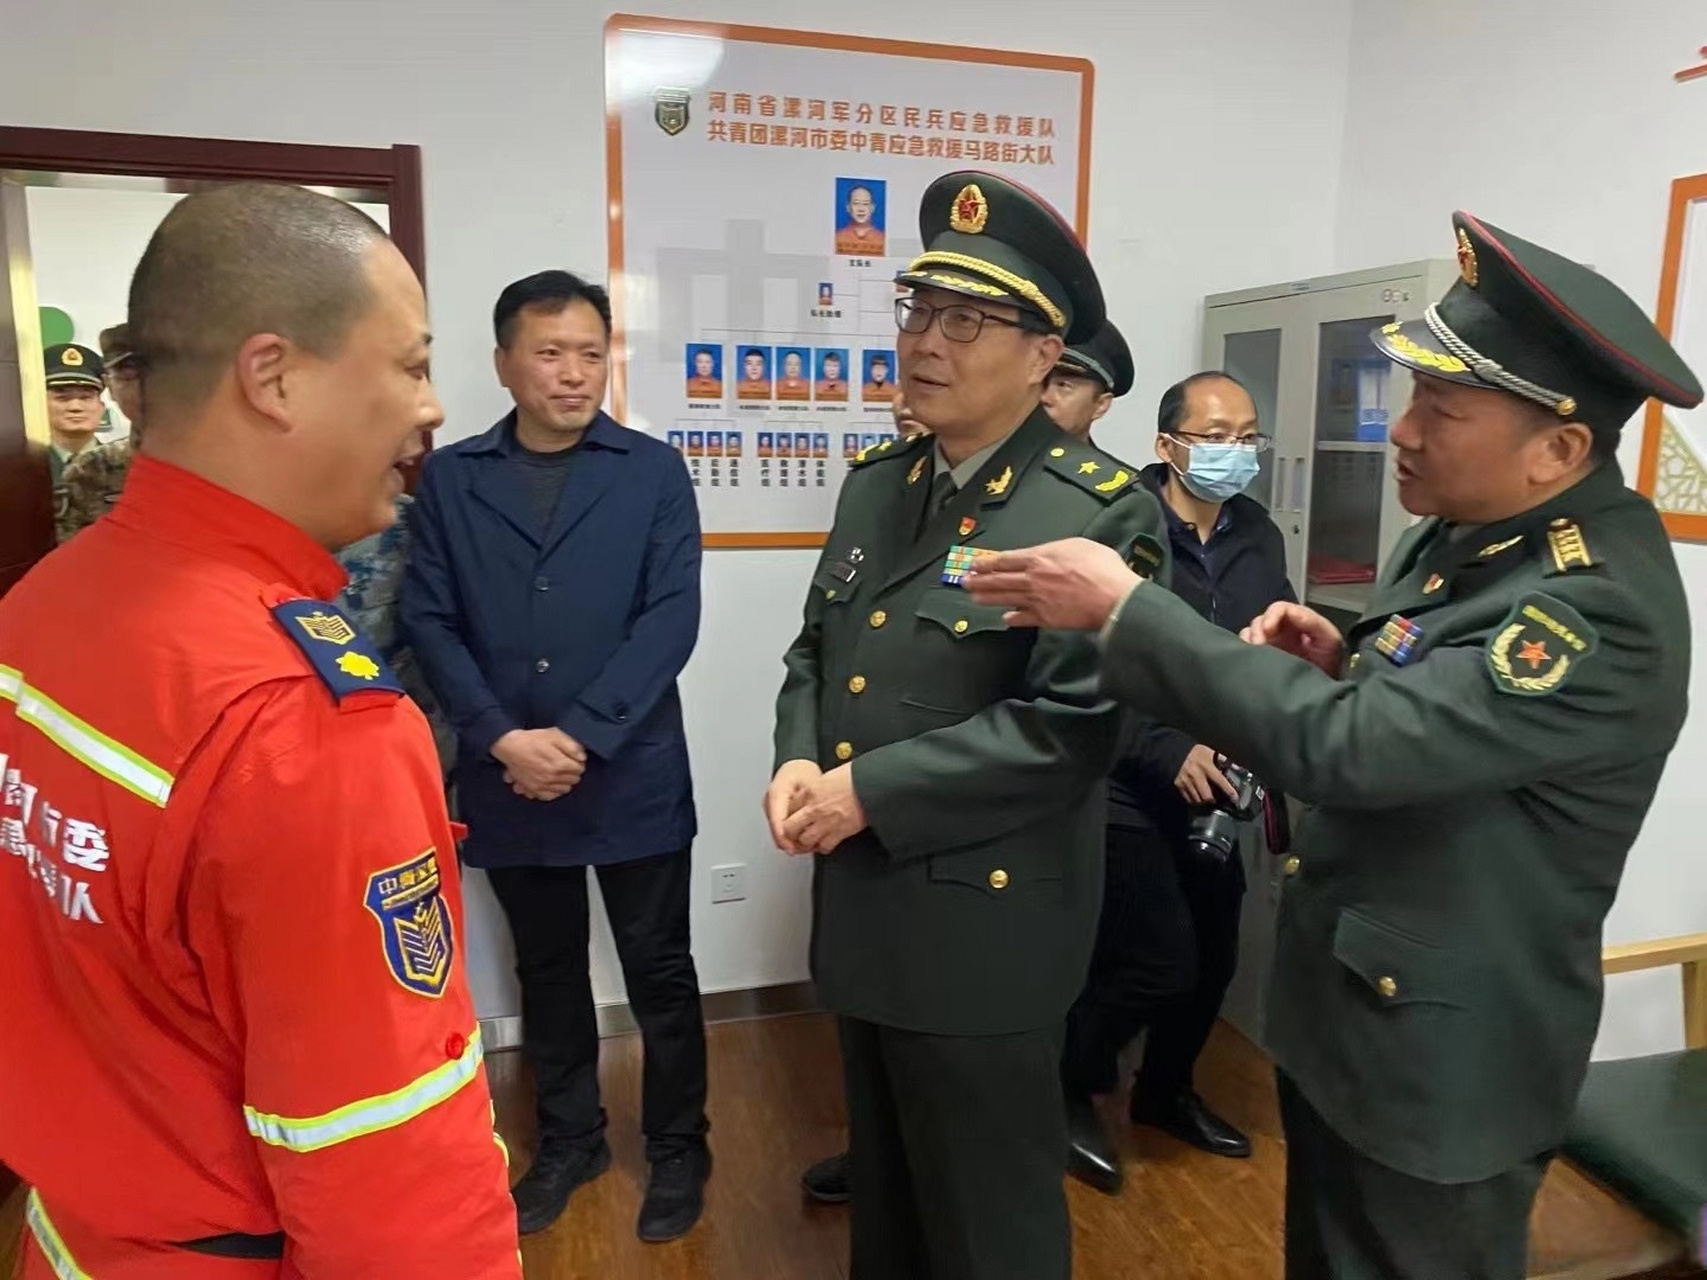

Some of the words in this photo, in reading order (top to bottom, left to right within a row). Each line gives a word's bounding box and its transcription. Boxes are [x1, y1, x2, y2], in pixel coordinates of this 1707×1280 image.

[708, 91, 1056, 138] 河南省漯河军分区民兵应急救援队
[707, 119, 1055, 165] 共青团漯河市委中青应急救援马路街大队
